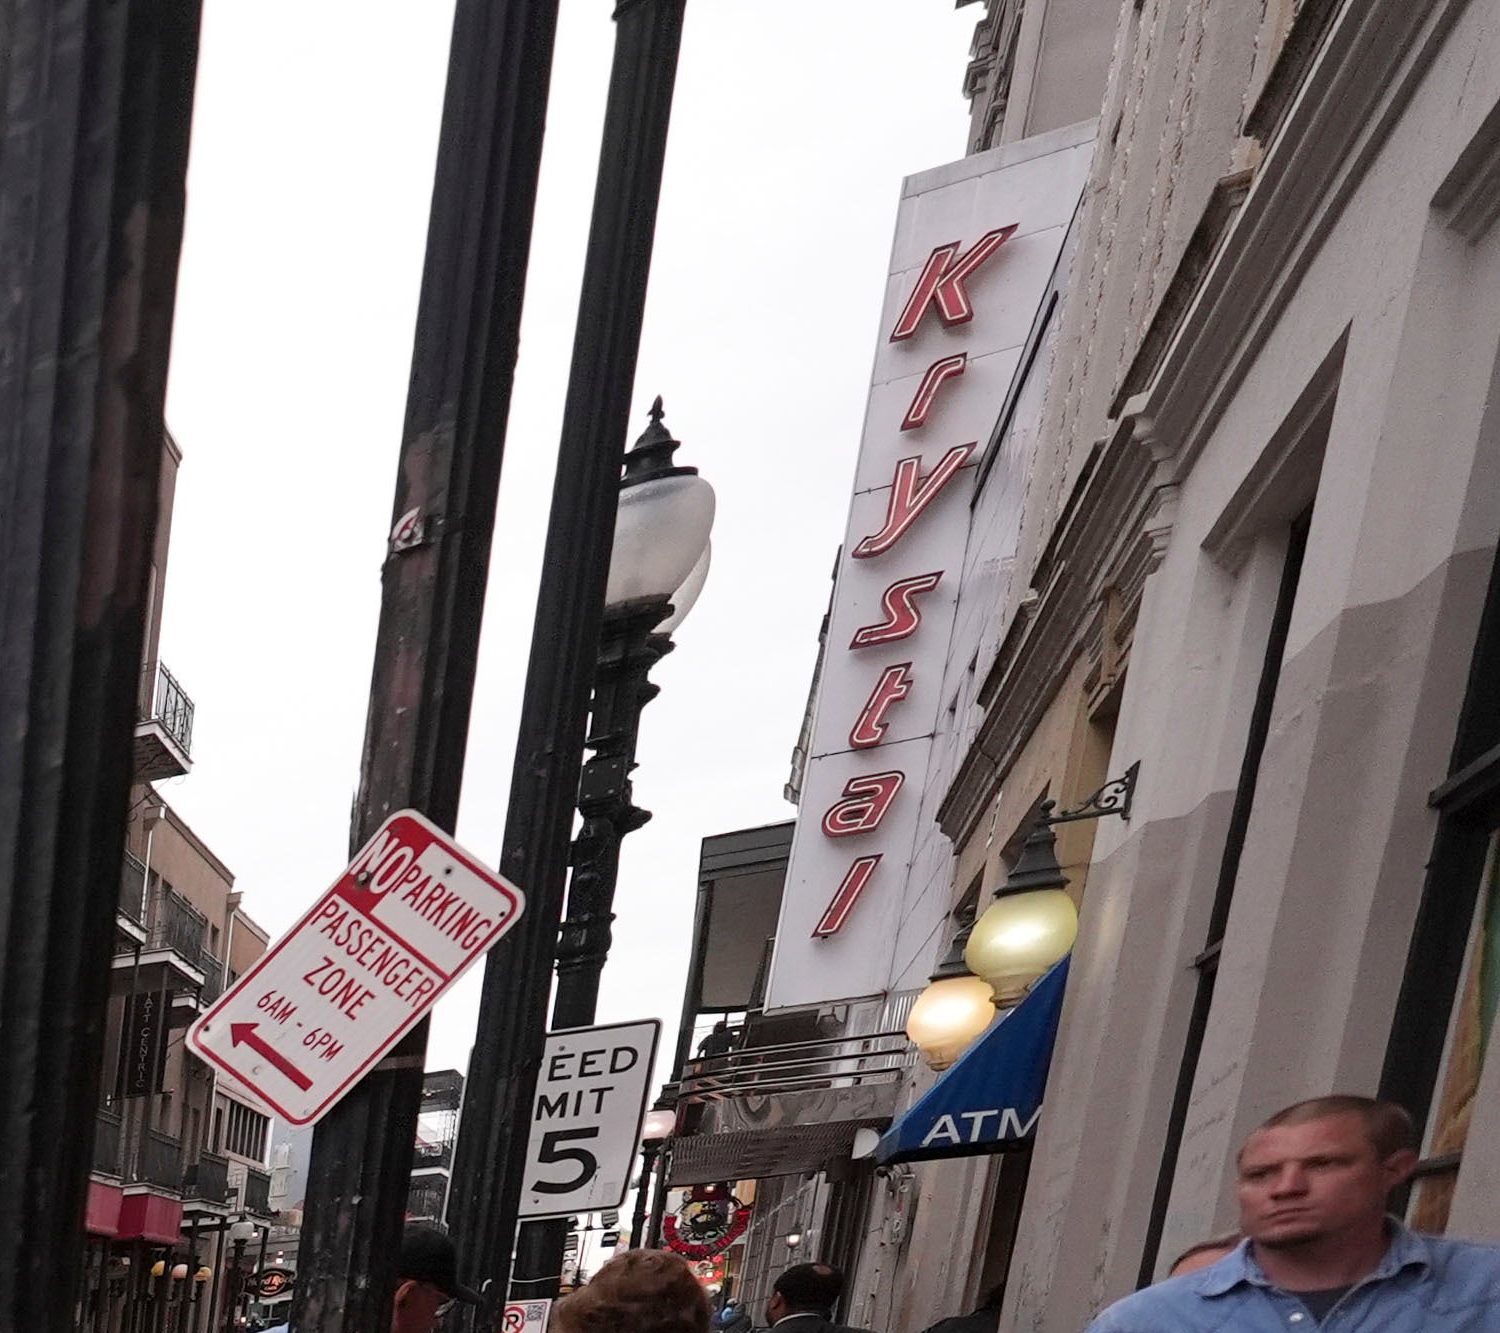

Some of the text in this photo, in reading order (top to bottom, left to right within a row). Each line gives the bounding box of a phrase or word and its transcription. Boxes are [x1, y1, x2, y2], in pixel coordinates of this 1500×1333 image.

[812, 223, 1020, 938] Krystal
[350, 830, 493, 951] NO PARKING
[311, 899, 435, 1007] PASSENGER
[303, 956, 376, 1021] ZONE
[256, 989, 299, 1026] 6AM
[303, 1027, 344, 1063] 6PM
[548, 1046, 639, 1082] EED
[535, 1087, 614, 1121] MIT
[919, 1105, 1043, 1149] ATM
